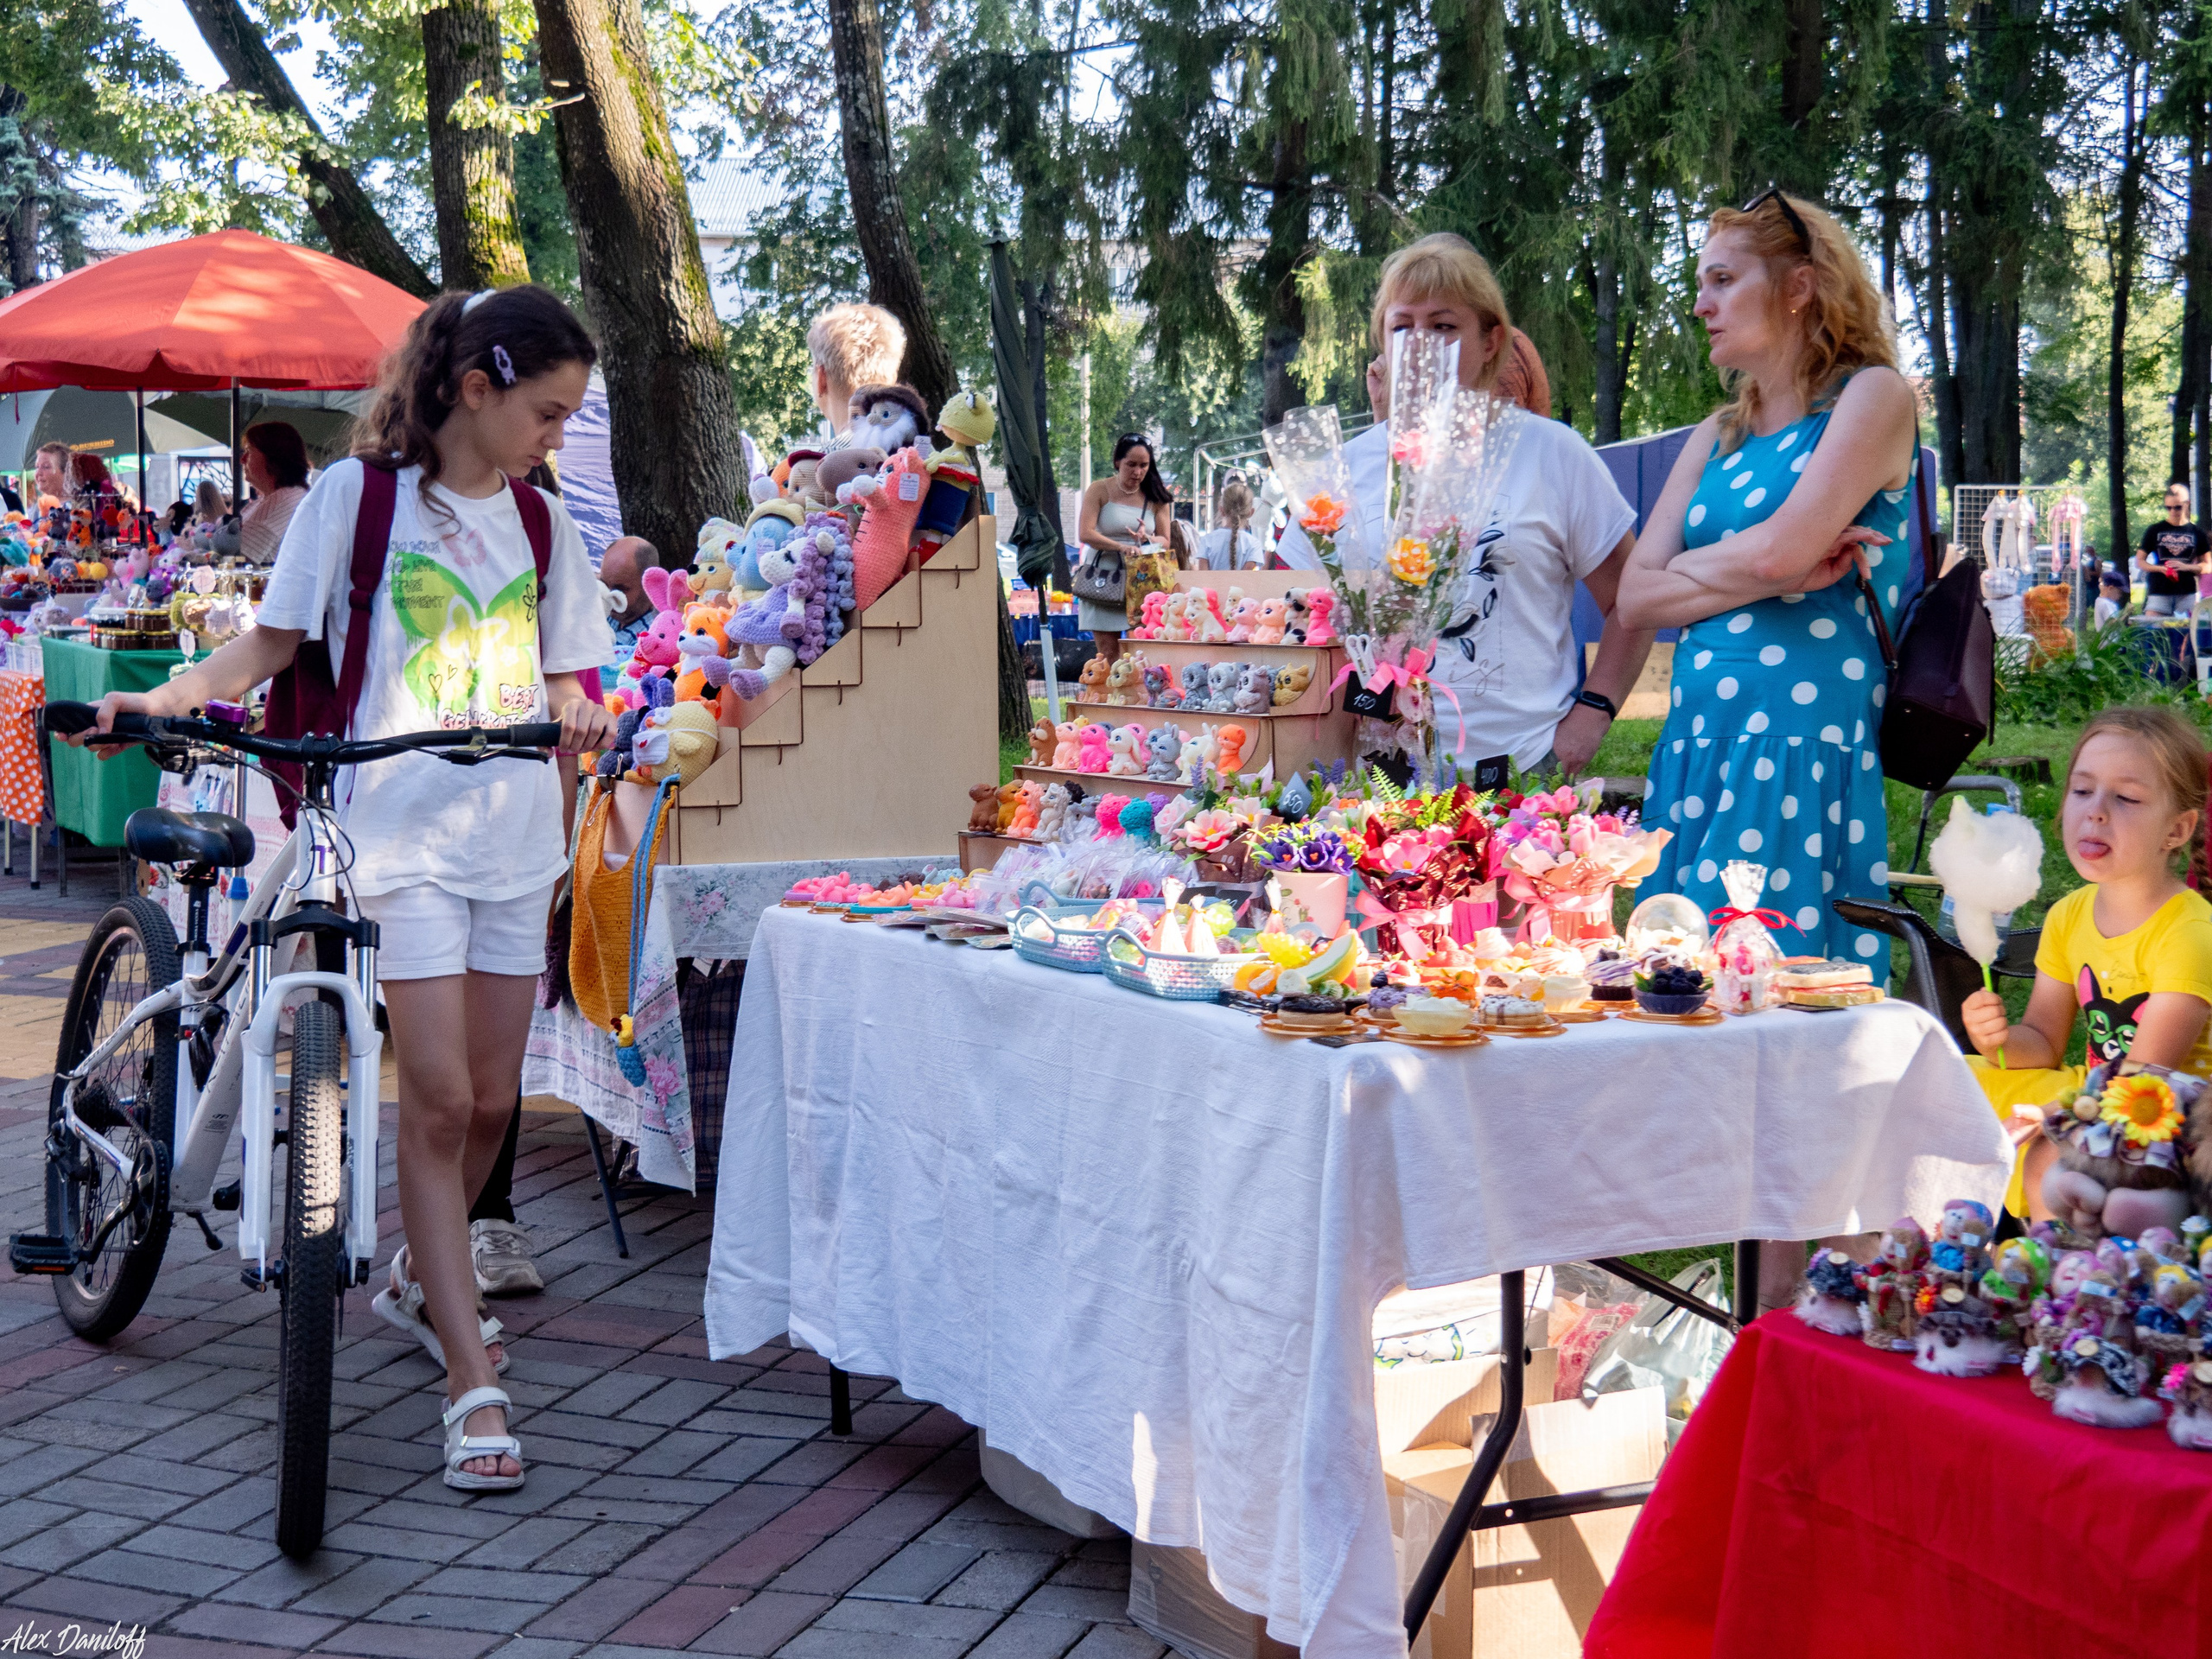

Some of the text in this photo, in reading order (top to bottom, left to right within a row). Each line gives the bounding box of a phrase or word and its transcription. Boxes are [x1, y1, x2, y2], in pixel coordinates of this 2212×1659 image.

[499, 683, 539, 714] BEST
[1353, 693, 1376, 710] 150
[1282, 789, 1304, 814] 650
